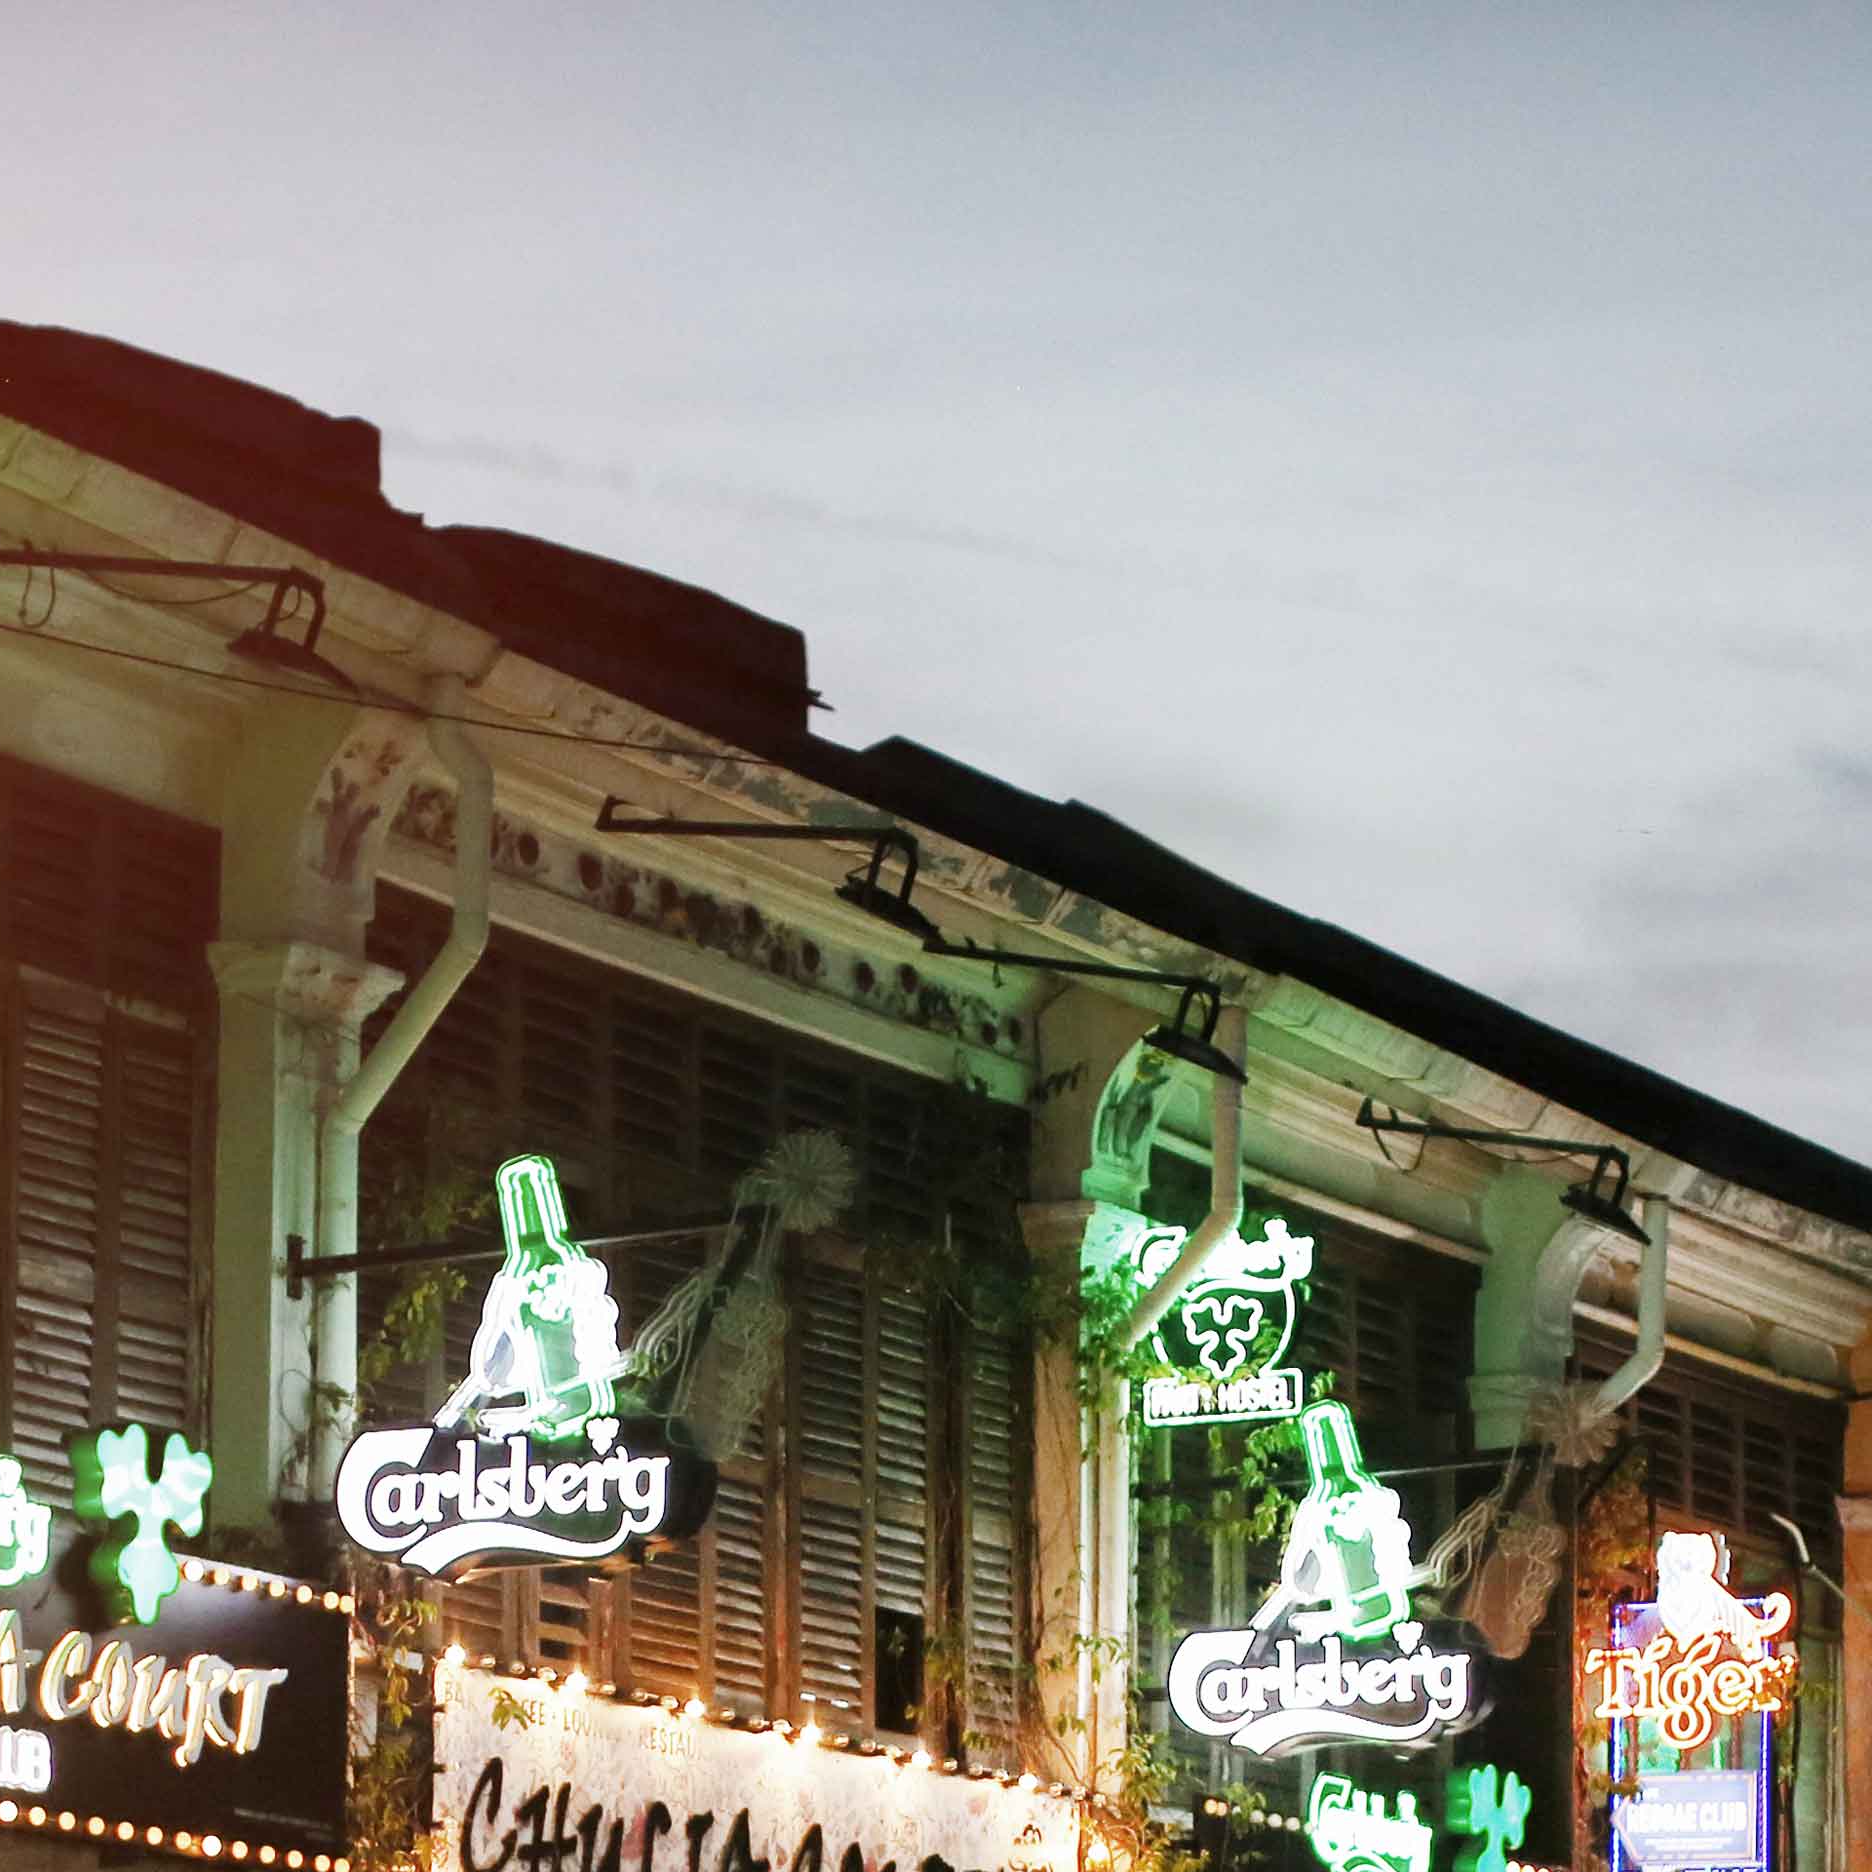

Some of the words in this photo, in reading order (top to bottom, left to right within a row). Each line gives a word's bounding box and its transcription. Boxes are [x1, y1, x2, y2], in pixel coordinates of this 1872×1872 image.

[338, 1420, 670, 1575] Carlsberg
[40, 1631, 288, 1767] COURT
[1169, 1624, 1470, 1755] Carlsberg
[1585, 1634, 1796, 1748] Tiger
[1700, 1801, 1747, 1832] CLUB
